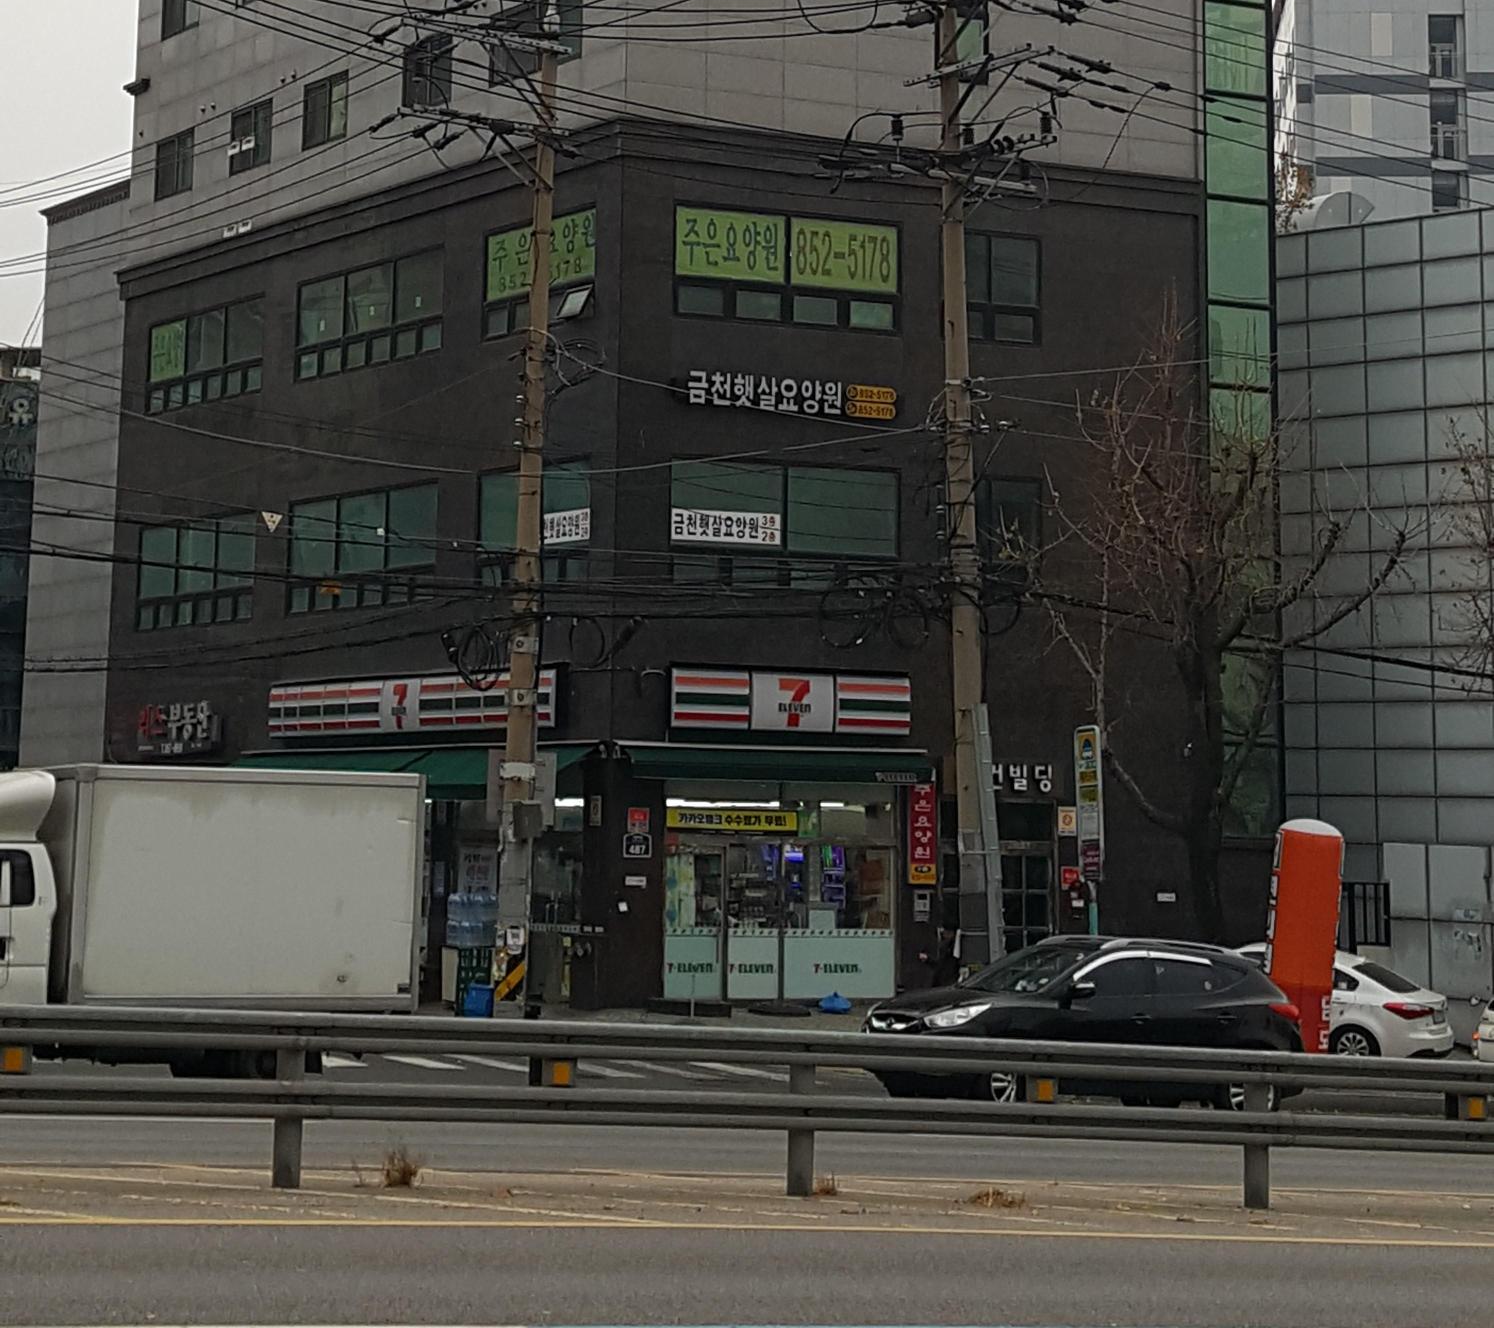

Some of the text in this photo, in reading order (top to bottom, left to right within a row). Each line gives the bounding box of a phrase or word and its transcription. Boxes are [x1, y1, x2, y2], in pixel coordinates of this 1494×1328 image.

[682, 218, 891, 283] 주은요양원 852-5178
[688, 370, 842, 415] 금천햇살요양원
[673, 513, 759, 539] 금천햇살요양원
[778, 678, 810, 727] 7
